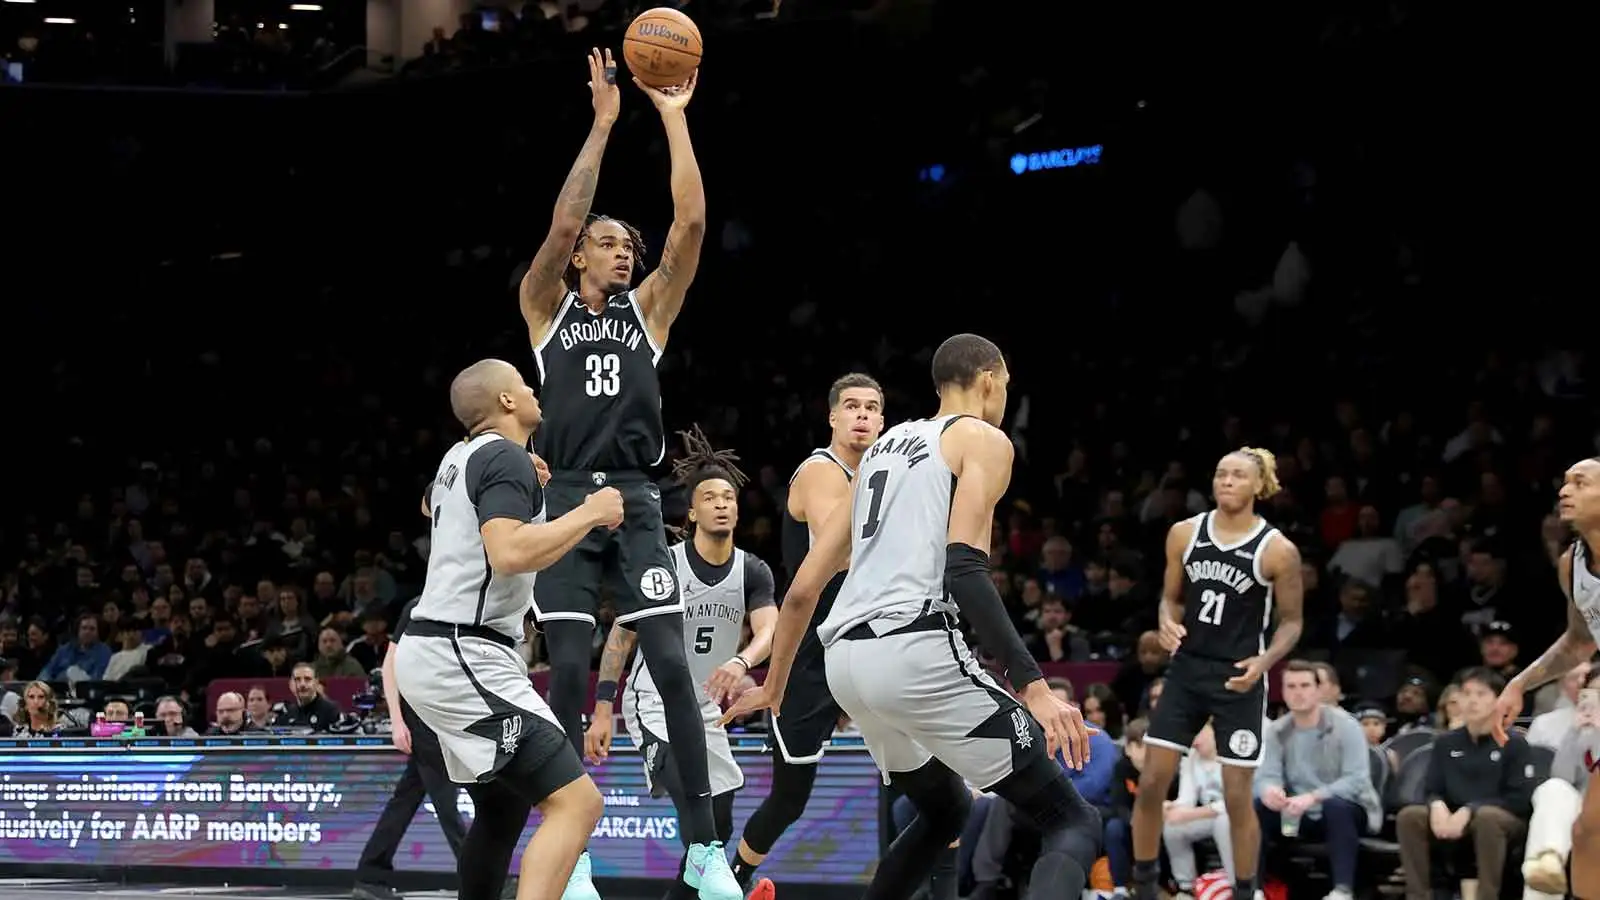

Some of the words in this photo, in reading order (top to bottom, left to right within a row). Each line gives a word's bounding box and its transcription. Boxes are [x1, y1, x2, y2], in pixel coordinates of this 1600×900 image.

[639, 23, 689, 47] Wilson
[559, 317, 643, 351] BROOKLYN
[585, 353, 621, 397] 33
[861, 469, 889, 539] 1
[1184, 560, 1255, 594] BROOKLYN
[696, 602, 741, 624] ANTONIO
[1198, 589, 1226, 625] 21
[693, 626, 715, 655] 5
[0, 774, 49, 809] ings
[56, 774, 158, 801] solutions
[164, 774, 222, 802] from
[230, 774, 342, 811] Barclays,
[0, 811, 84, 848] lusively
[91, 811, 126, 840] for
[132, 813, 200, 841] AARP
[207, 812, 322, 842] members
